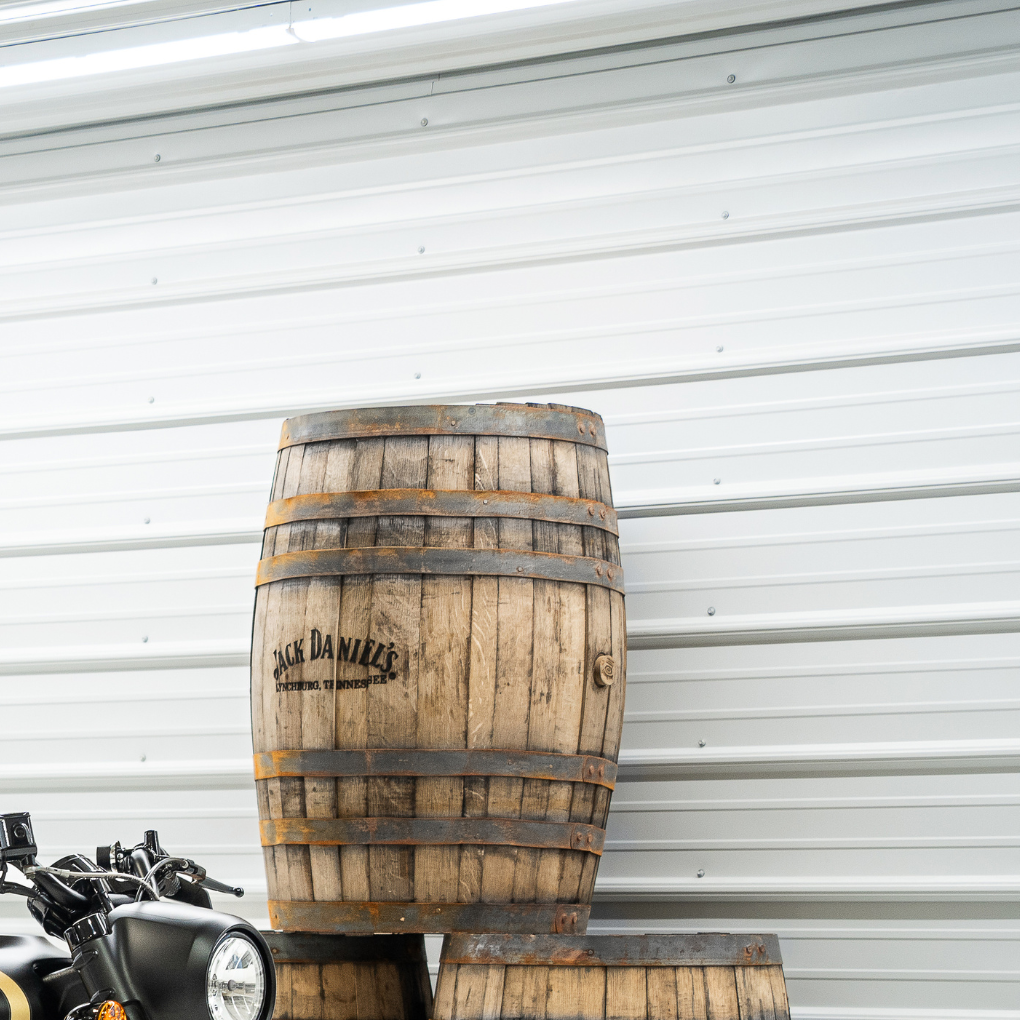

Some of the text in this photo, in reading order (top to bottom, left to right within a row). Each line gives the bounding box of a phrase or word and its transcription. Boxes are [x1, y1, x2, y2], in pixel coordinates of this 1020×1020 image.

[273, 628, 399, 680] JACK DANIEL'S
[323, 674, 388, 690] TENNESSEE
